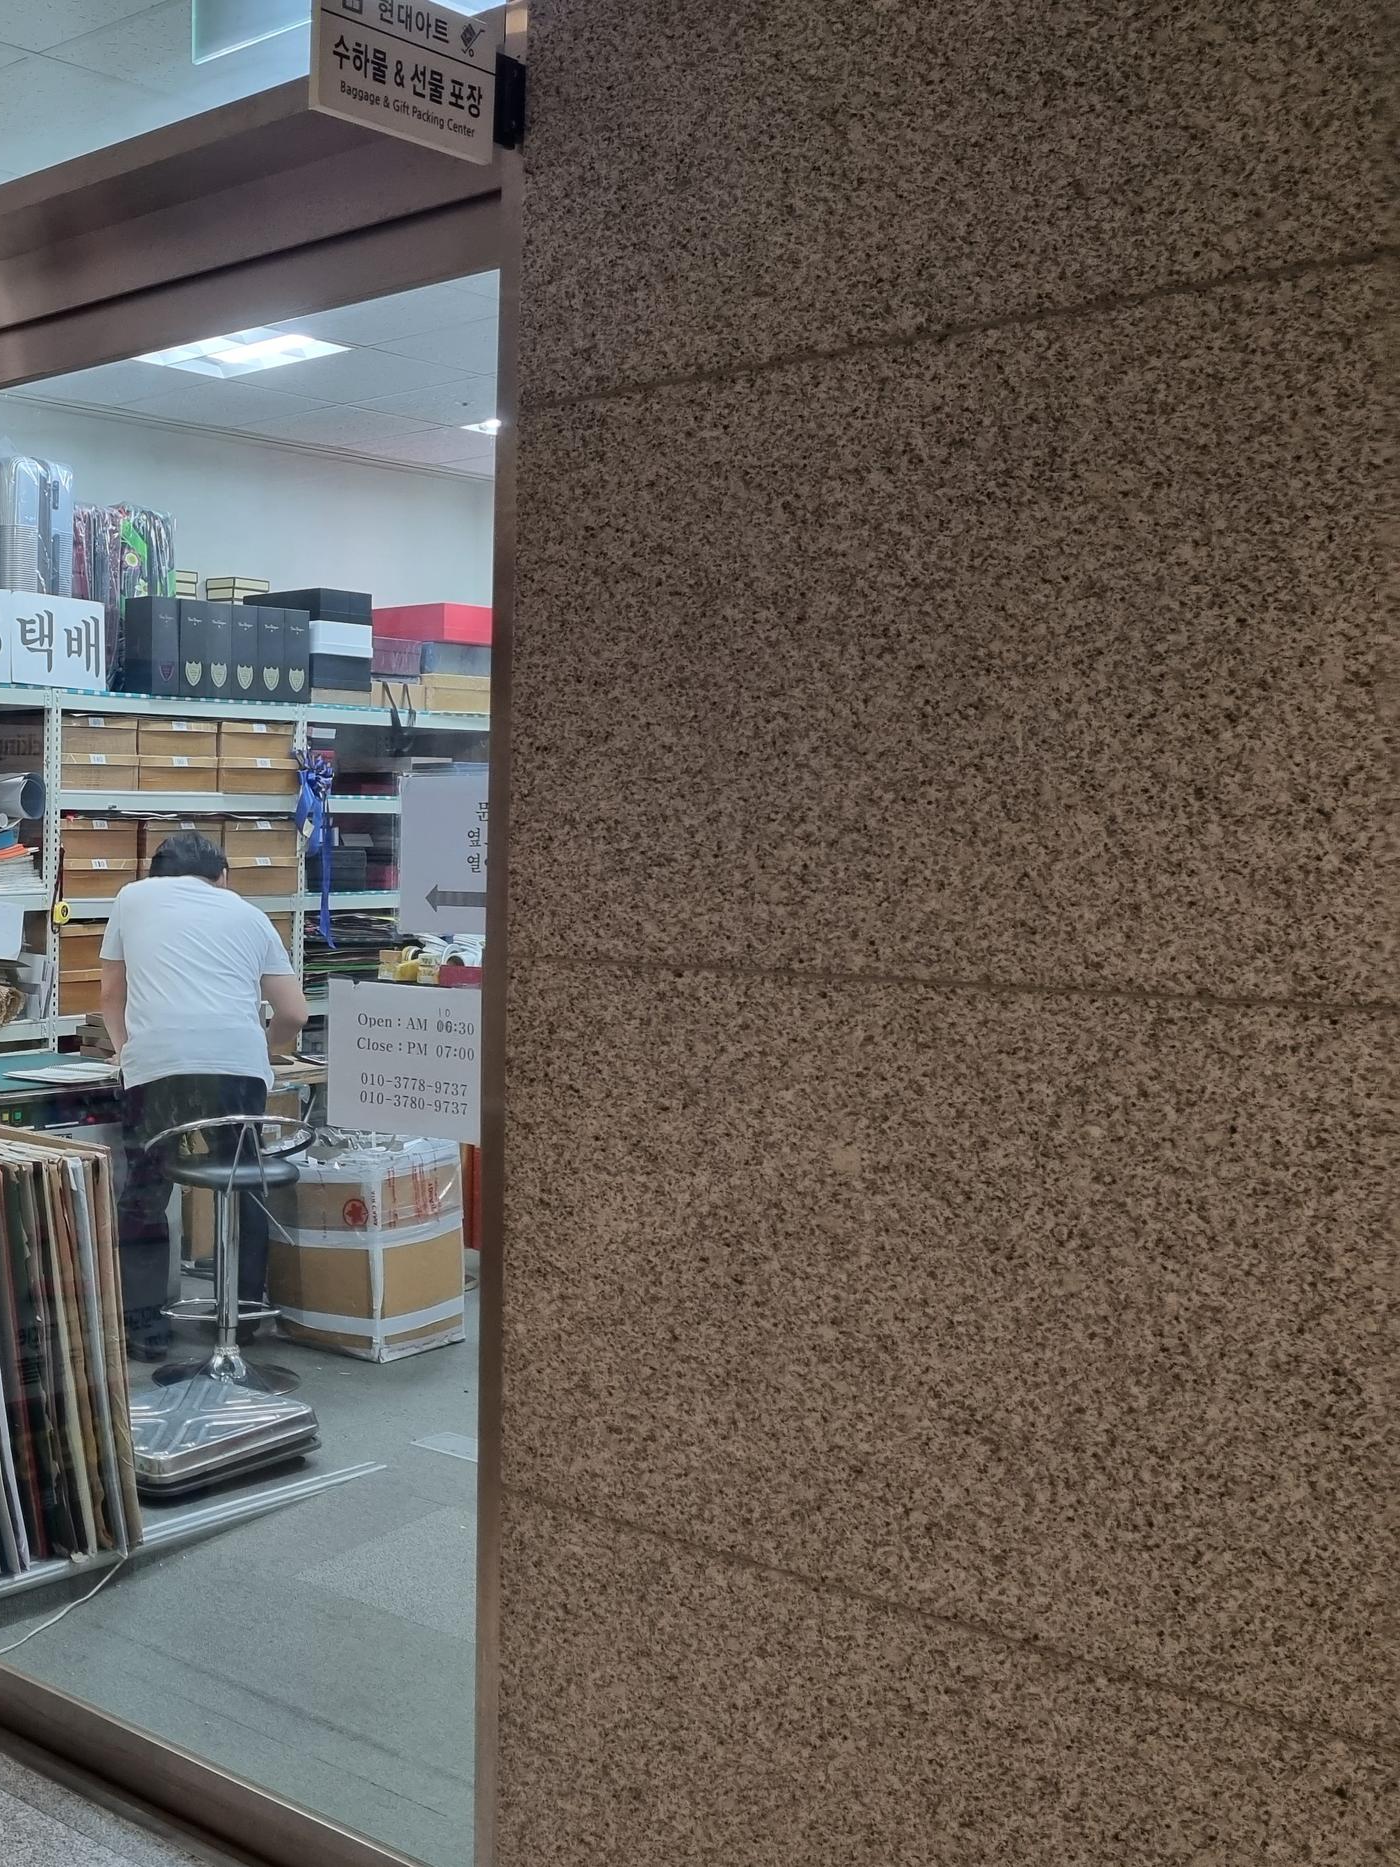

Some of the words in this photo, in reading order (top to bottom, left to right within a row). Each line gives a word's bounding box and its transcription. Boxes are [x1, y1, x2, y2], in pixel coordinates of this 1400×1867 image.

[379, 0, 450, 44] 현대아트
[332, 35, 388, 85] 수하물
[394, 60, 405, 88] &
[340, 80, 381, 106] Baggage
[383, 95, 391, 109] &
[393, 99, 410, 116] Gift
[412, 107, 445, 130] Packing
[447, 118, 476, 138] Center
[357, 1013, 392, 1028] Open
[406, 1017, 428, 1031] AM
[357, 1037, 393, 1052] Close
[407, 1041, 428, 1056] PM
[436, 1045, 475, 1061] 07:00
[361, 1072, 468, 1097] 010-3778-9737
[360, 1090, 468, 1116] 010-3780-9737
